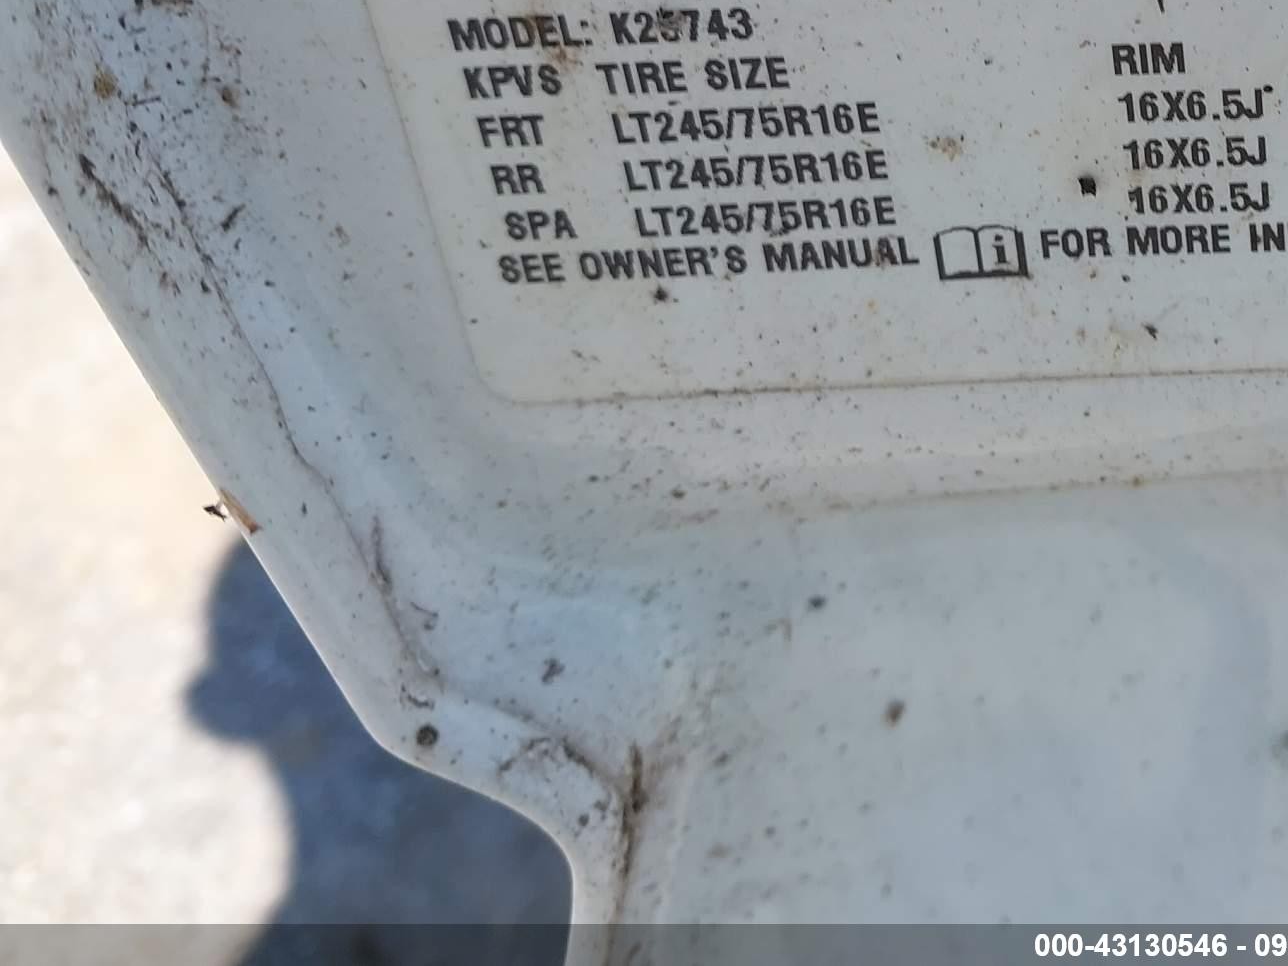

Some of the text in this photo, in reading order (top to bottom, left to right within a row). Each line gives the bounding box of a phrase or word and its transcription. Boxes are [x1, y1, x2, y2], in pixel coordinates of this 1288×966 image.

[447, 14, 592, 52] MODEL:
[1112, 42, 1185, 75] RIM
[463, 64, 562, 98] KPVS
[595, 57, 790, 95] TIRE SIZE
[1118, 88, 1263, 123] 16X6.5J
[477, 115, 543, 147] FRT
[611, 102, 880, 144] LT245/75R16E
[1123, 136, 1267, 170] 16X6.5J
[490, 164, 545, 194] RR
[623, 150, 888, 191] LT245/75R16E
[1128, 182, 1270, 214] 16X6.5J
[505, 210, 577, 240] SPA
[635, 196, 896, 237] LT245/75R16E
[499, 254, 565, 283] SEE
[579, 245, 747, 281] OWNER'S
[762, 237, 920, 272] MANUAL
[1040, 227, 1112, 259] FOR
[1126, 224, 1230, 255] MORE
